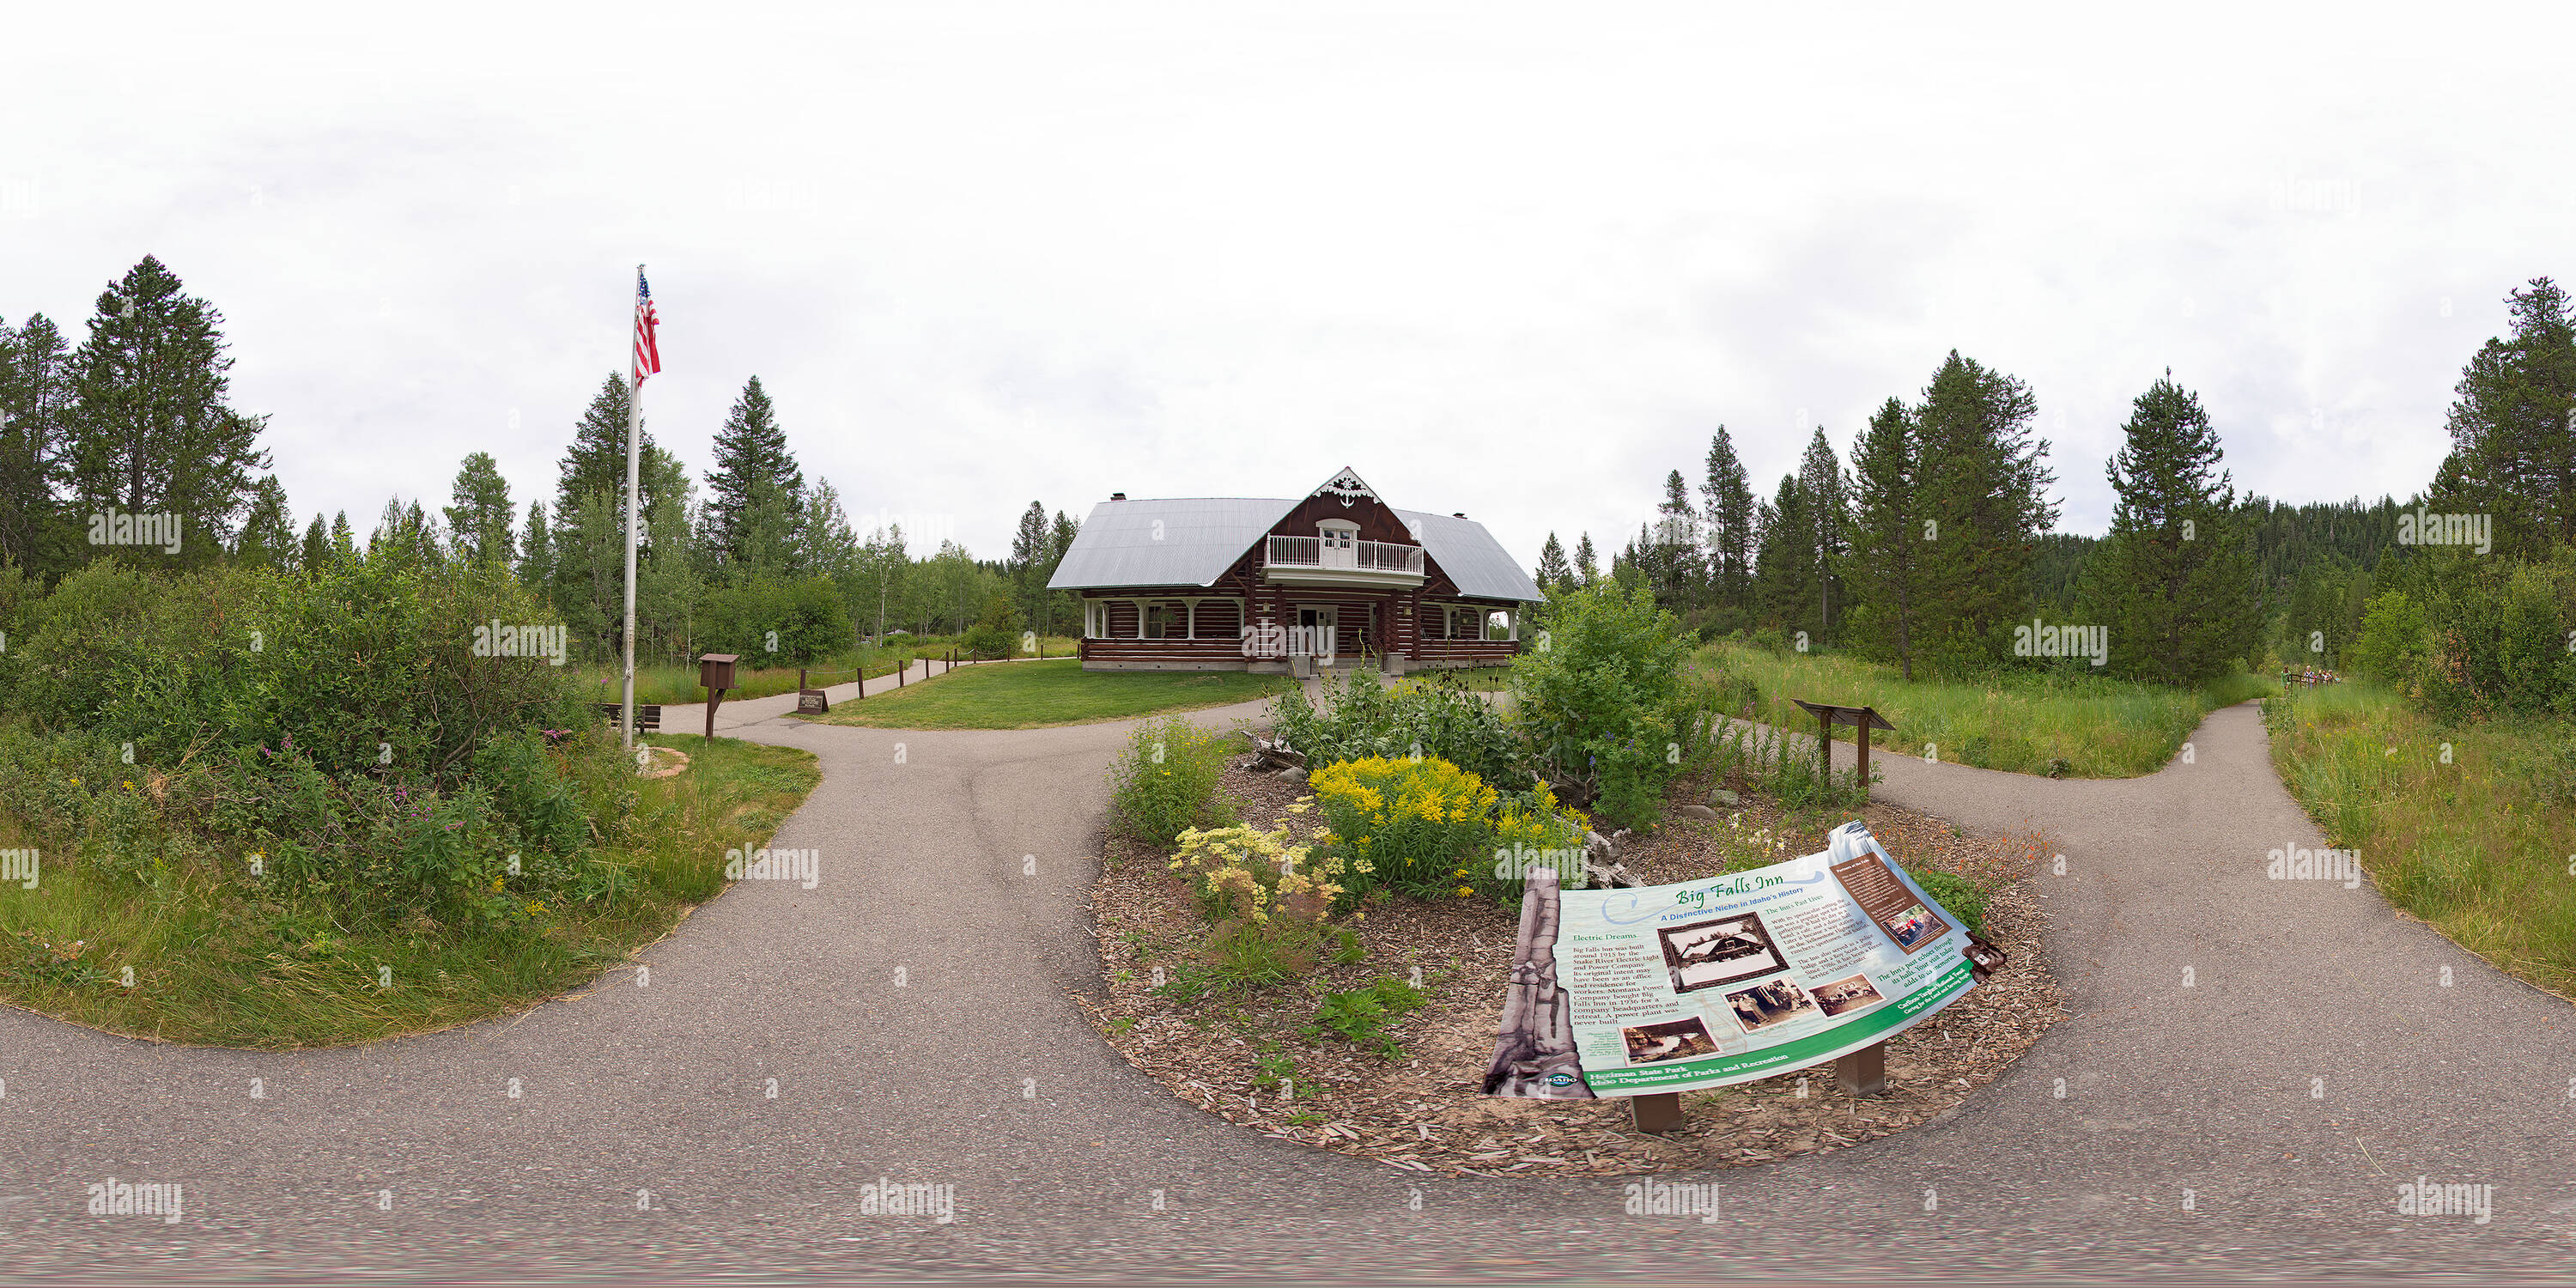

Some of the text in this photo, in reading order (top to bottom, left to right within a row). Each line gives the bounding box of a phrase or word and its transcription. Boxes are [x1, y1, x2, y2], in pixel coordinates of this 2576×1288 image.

[1676, 876, 1783, 908] Big Falls Inn
[1716, 903, 1739, 912] Niche
[1750, 895, 1777, 905] Idaho's
[1778, 887, 1803, 898] History
[1619, 1073, 1680, 1084] Department
[1694, 1067, 1720, 1076] Parks
[1742, 1054, 1789, 1069] Recreation
